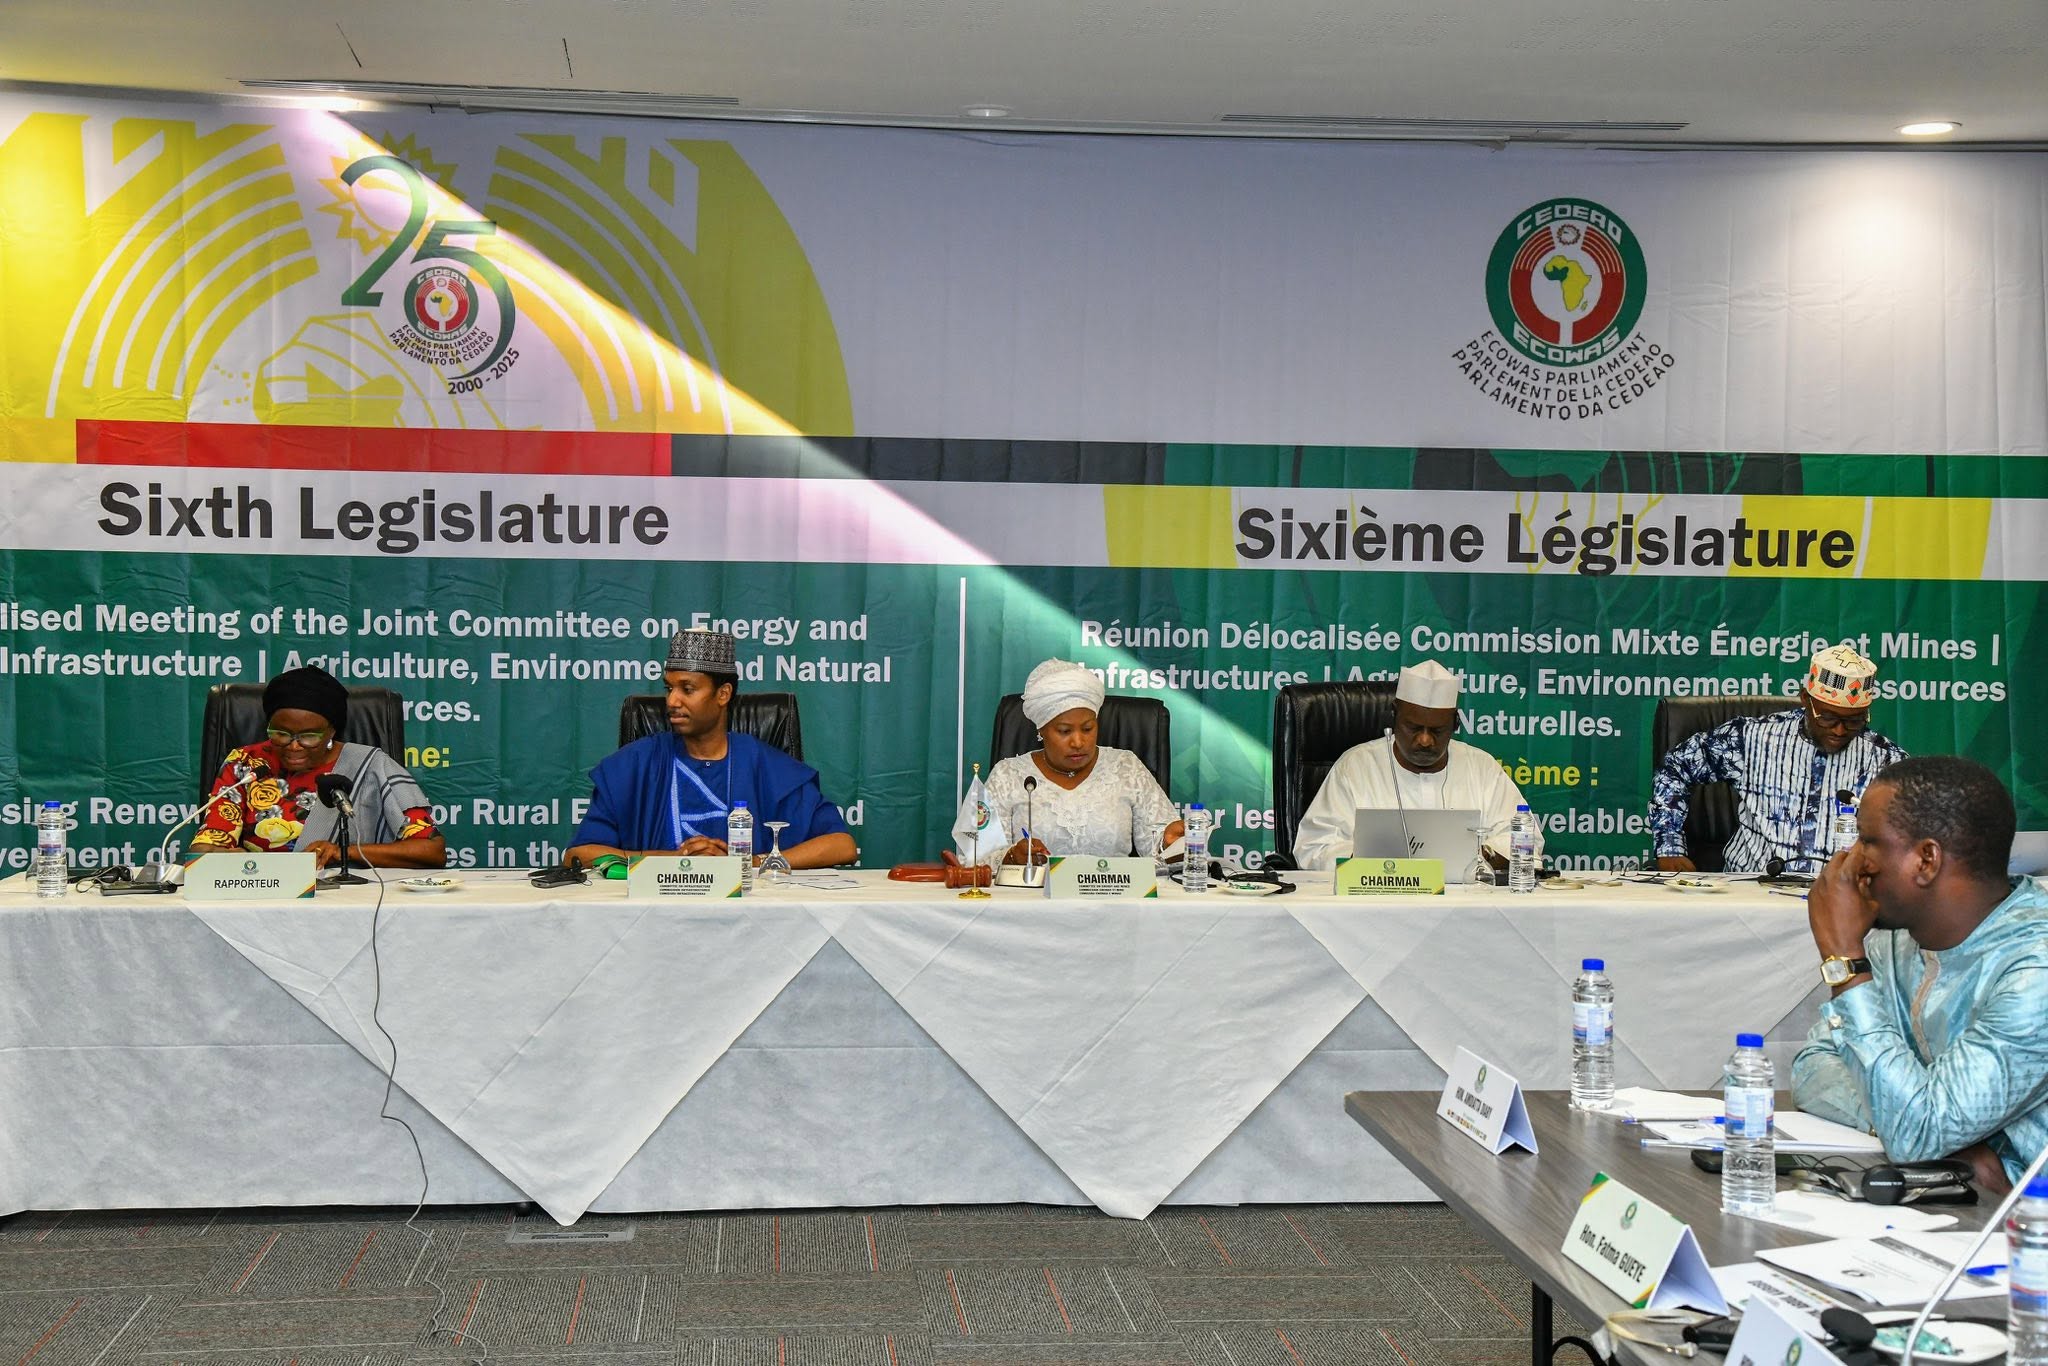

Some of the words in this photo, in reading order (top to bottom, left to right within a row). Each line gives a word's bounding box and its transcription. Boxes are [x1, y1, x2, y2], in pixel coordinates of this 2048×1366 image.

[389, 332, 447, 366] PARLAMENTO
[449, 356, 462, 366] DA
[462, 335, 495, 362] CEDEAO
[396, 328, 437, 357] PARLEMENT
[402, 324, 432, 349] ECOWAS
[433, 325, 481, 350] PARLIAMENT
[1513, 321, 1621, 364] ECOWAS
[448, 377, 484, 395] 2000
[490, 347, 520, 380] 2025
[1466, 340, 1551, 400] PARLEMENT
[1557, 388, 1578, 402] DE
[1583, 385, 1603, 400] LA
[1605, 343, 1662, 393] CEDEAO
[1481, 330, 1540, 382] ECOWAS
[1545, 332, 1647, 386] PARLIAMENT
[1452, 349, 1571, 421] PARLAMENTO
[1578, 403, 1604, 420] DA
[1608, 353, 1675, 410] CEDEAO
[98, 482, 273, 538] Sixth
[300, 486, 670, 554] Legislature
[1235, 507, 1485, 562] Sixième
[1508, 509, 1856, 576] Législature
[95, 604, 241, 640] Meeting
[250, 606, 284, 635] of
[292, 607, 348, 635] the
[357, 608, 439, 636] Joint
[449, 609, 631, 638] Committee
[641, 617, 679, 639] on
[691, 612, 801, 645] Energy
[809, 614, 867, 642] and
[1081, 618, 1208, 648] Réunion
[1221, 620, 1401, 650] Délocalisée
[1411, 624, 1600, 654] Commission
[1612, 628, 1700, 656] Mixte
[1710, 622, 1829, 663] Énergie
[1881, 632, 1977, 660] Mines
[0, 646, 242, 677] Infrastructure
[490, 652, 668, 681] Environme
[776, 655, 891, 683] Natural
[1078, 661, 1309, 690] nfrastructures
[1537, 668, 1773, 697] Environnement
[1455, 708, 1622, 737] Naturelles.
[90, 797, 200, 826] Renew
[430, 804, 462, 825] or
[473, 798, 559, 825] Rural
[1235, 802, 1275, 830] les
[146, 840, 181, 867] of
[487, 841, 516, 867] in
[526, 841, 568, 867] th
[214, 879, 280, 889] RAPPORTEUR
[657, 873, 714, 884] CHAIRMAN
[1077, 874, 1131, 884] CHAIRMAN
[1361, 875, 1420, 887] CHAIRMAN
[1579, 1224, 1595, 1249] Hon.
[1596, 1236, 1620, 1265] Fatma
[1618, 1252, 1647, 1283] GUEYE
